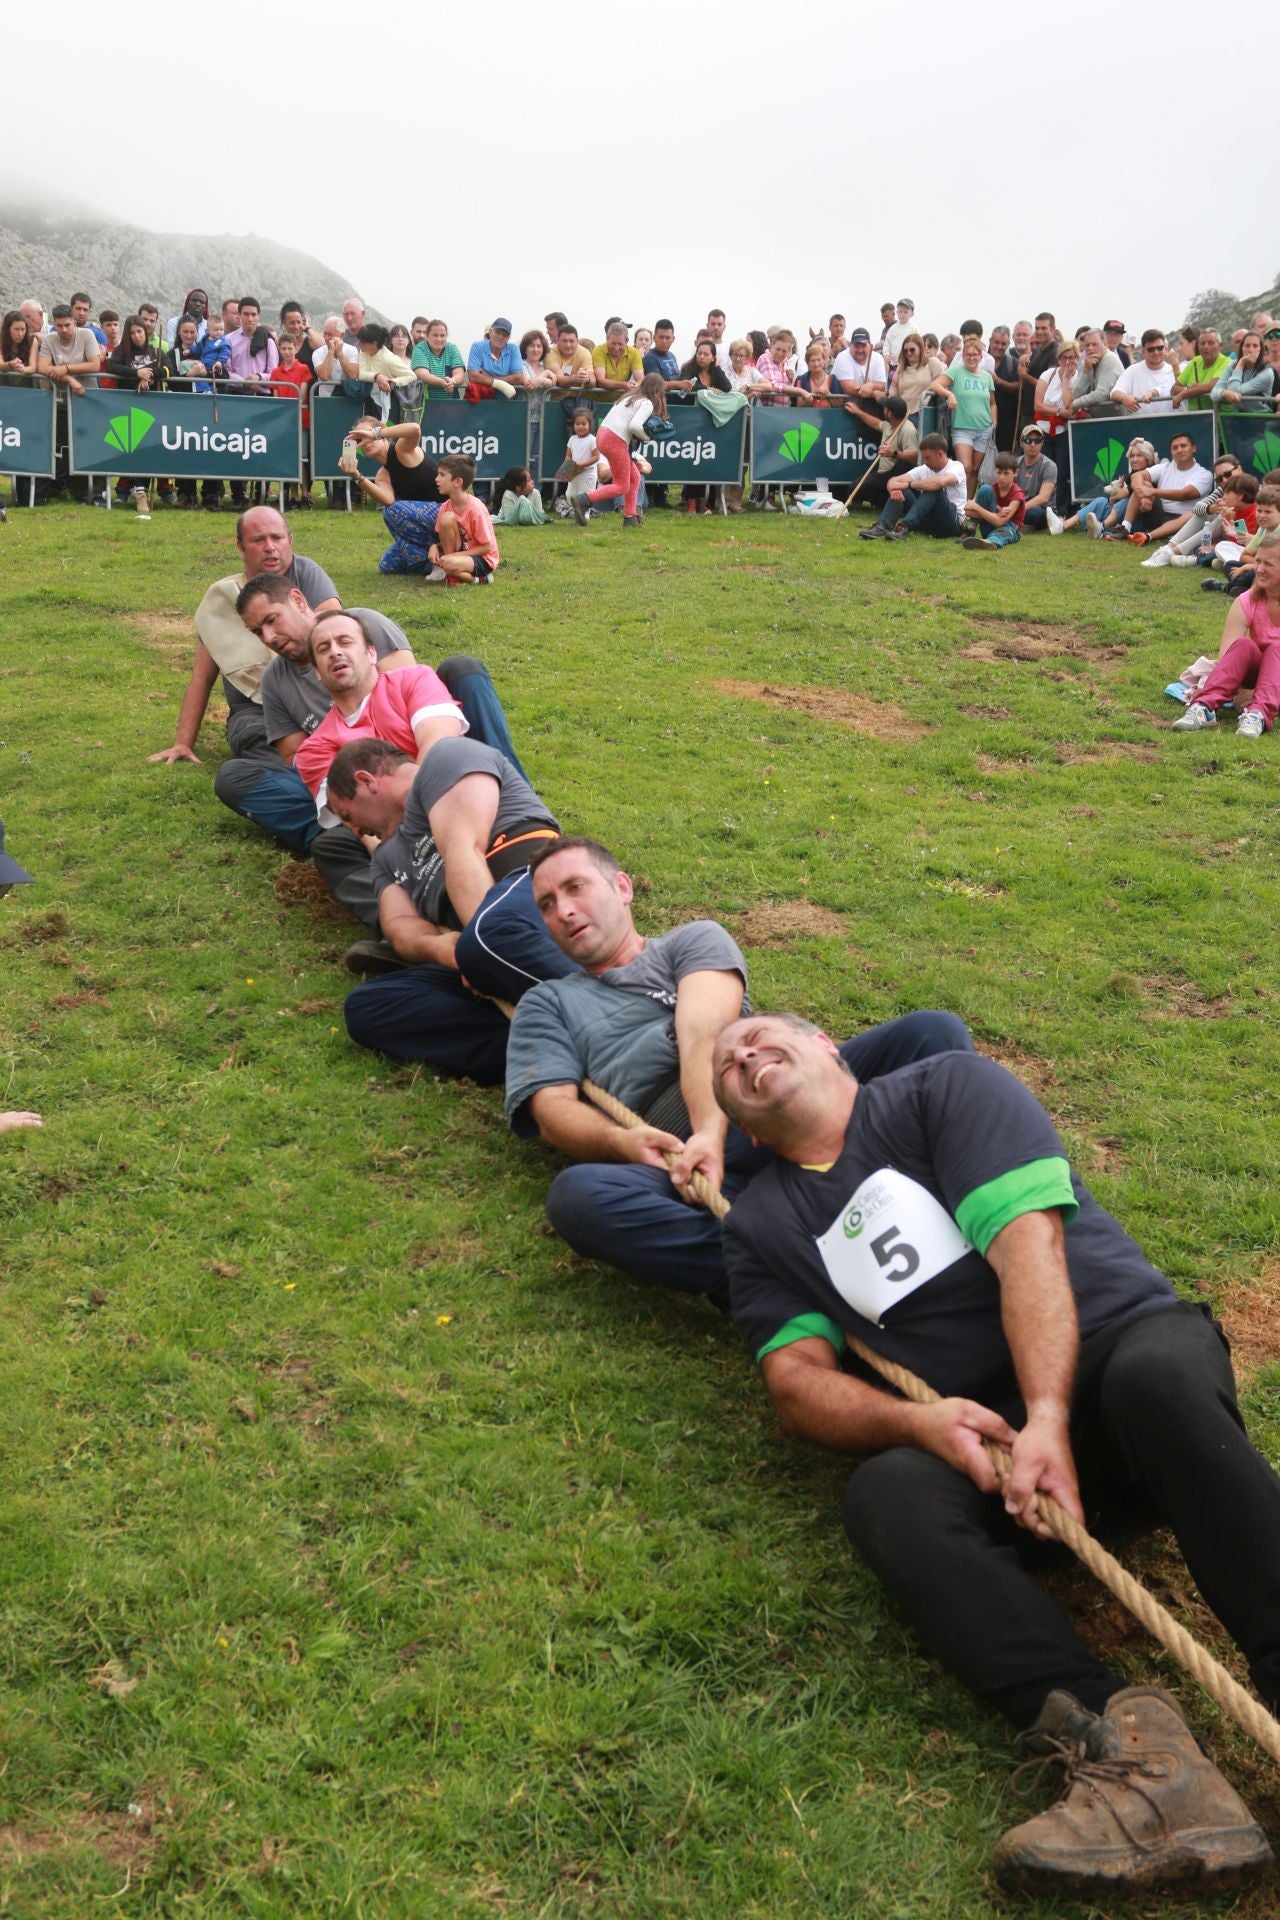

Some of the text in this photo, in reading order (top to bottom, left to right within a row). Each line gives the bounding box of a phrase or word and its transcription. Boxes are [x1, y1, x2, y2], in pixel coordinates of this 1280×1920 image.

[0, 420, 21, 452] ja
[161, 425, 267, 460] Unicaja
[421, 429, 499, 461] nicaja
[637, 436, 716, 466] nicaja
[825, 437, 878, 460] Unic
[869, 1225, 920, 1282] 5
